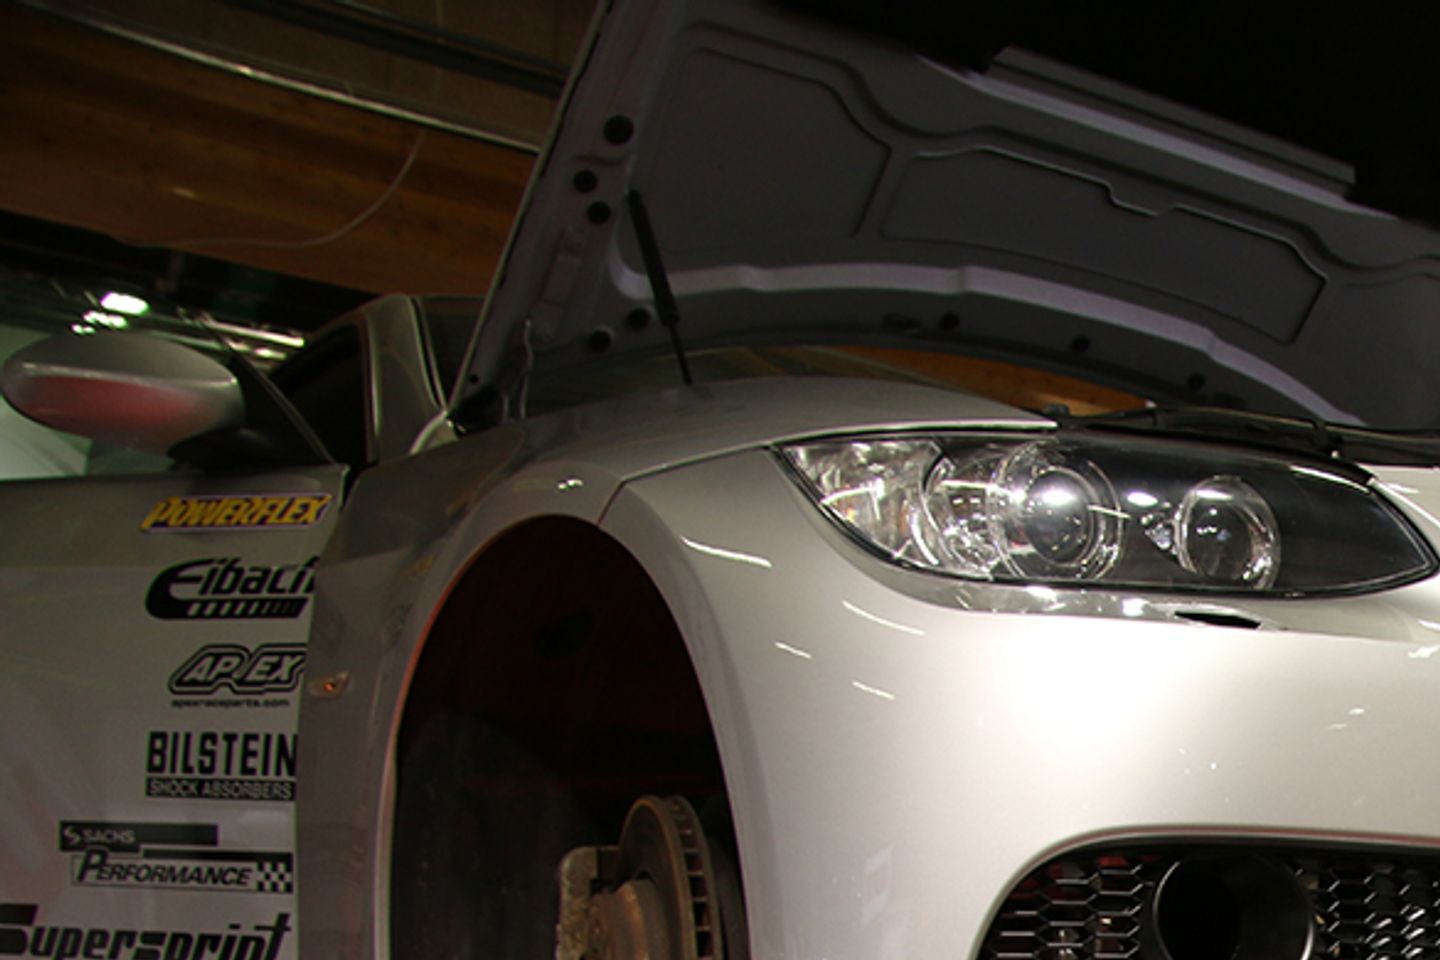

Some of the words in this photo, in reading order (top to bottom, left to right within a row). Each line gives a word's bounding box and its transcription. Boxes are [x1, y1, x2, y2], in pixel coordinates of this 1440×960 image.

[141, 495, 331, 531] POWERFLEX
[145, 556, 320, 619] Eibach
[174, 648, 306, 690] APEX
[146, 731, 297, 777] BILSTEIN
[149, 779, 198, 797] SHOCK
[202, 781, 293, 799] ABSORBERS
[83, 828, 135, 844] SACHS
[77, 848, 254, 886] PERFORMANCE
